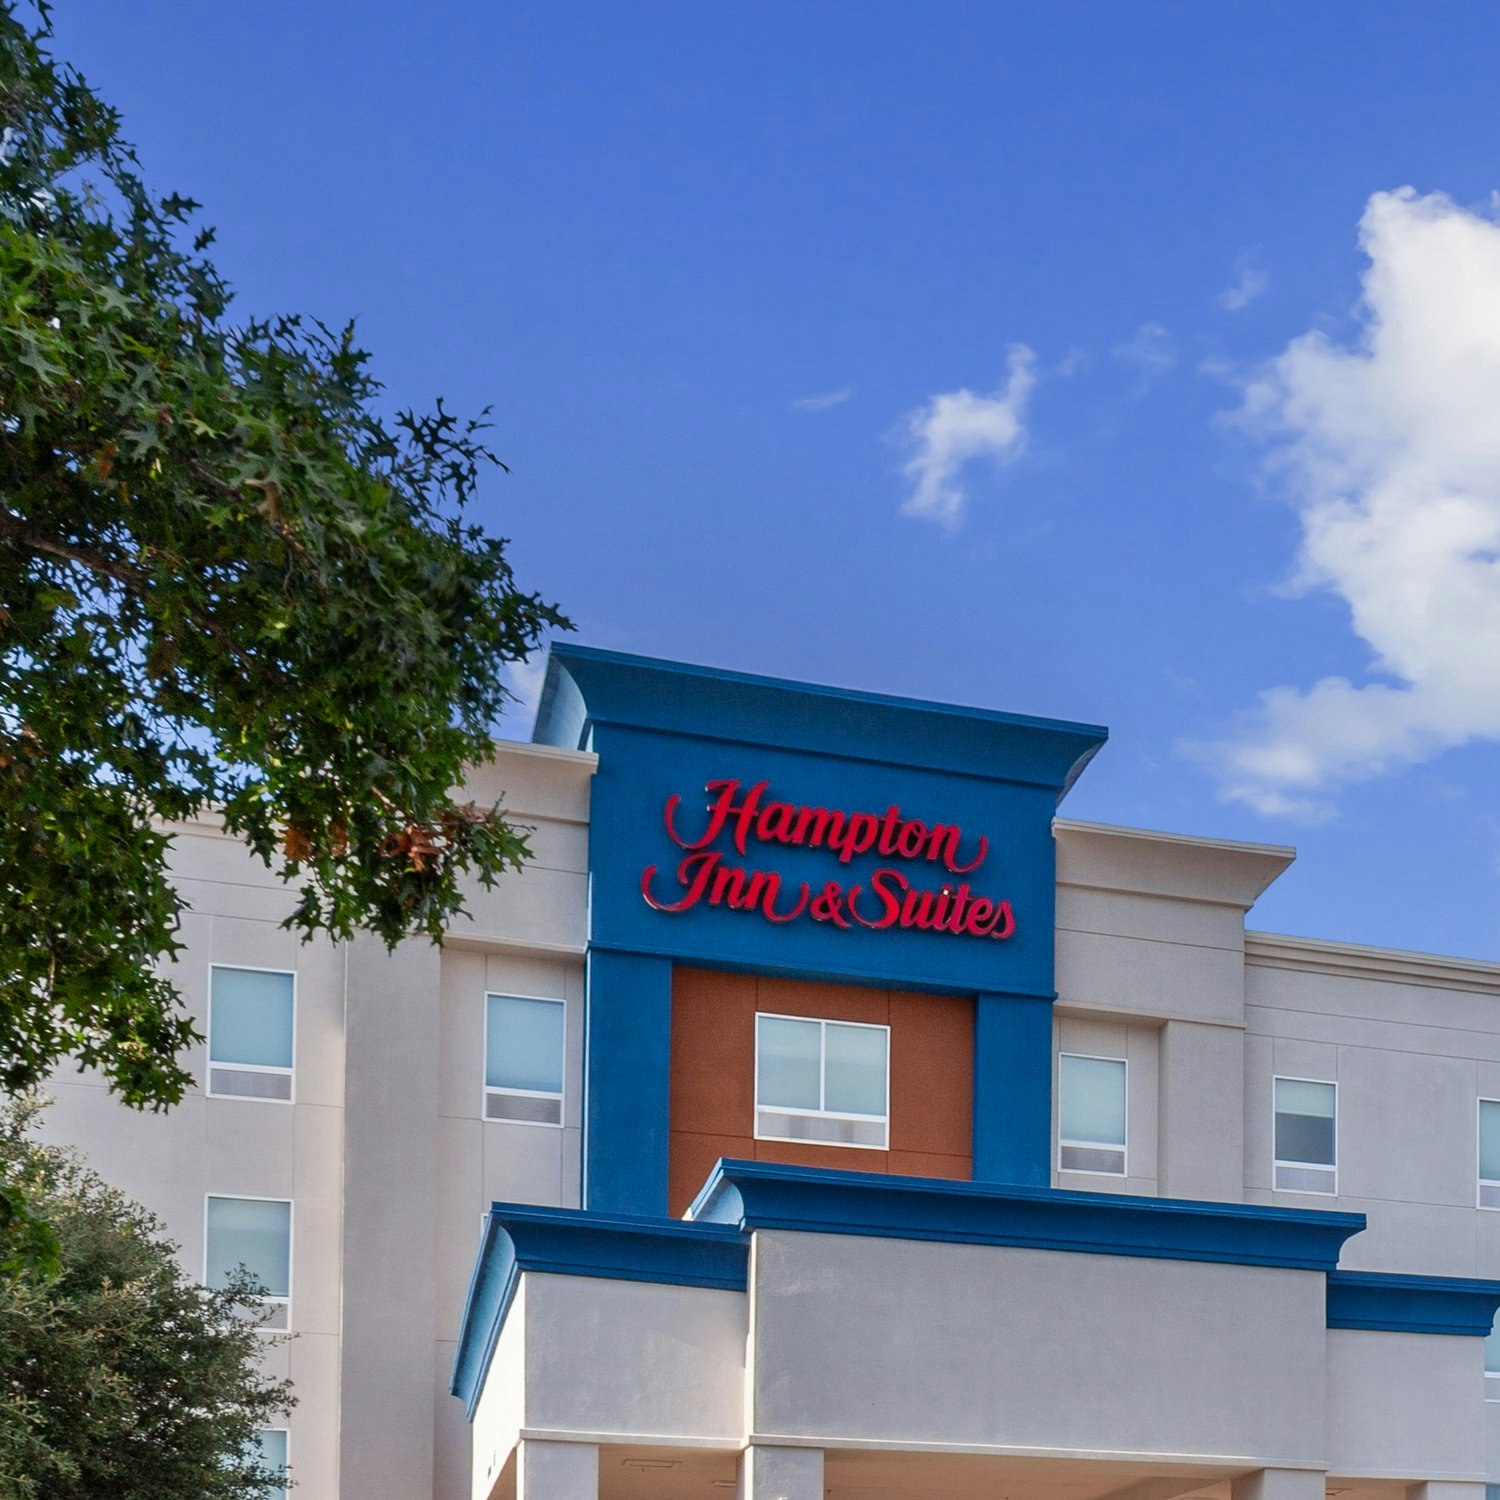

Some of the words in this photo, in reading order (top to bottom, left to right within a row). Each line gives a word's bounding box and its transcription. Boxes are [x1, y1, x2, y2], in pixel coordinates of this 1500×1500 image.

[664, 778, 989, 873] Hampton
[640, 851, 810, 923] Inn
[810, 880, 851, 928] &
[848, 868, 1016, 939] Suites
